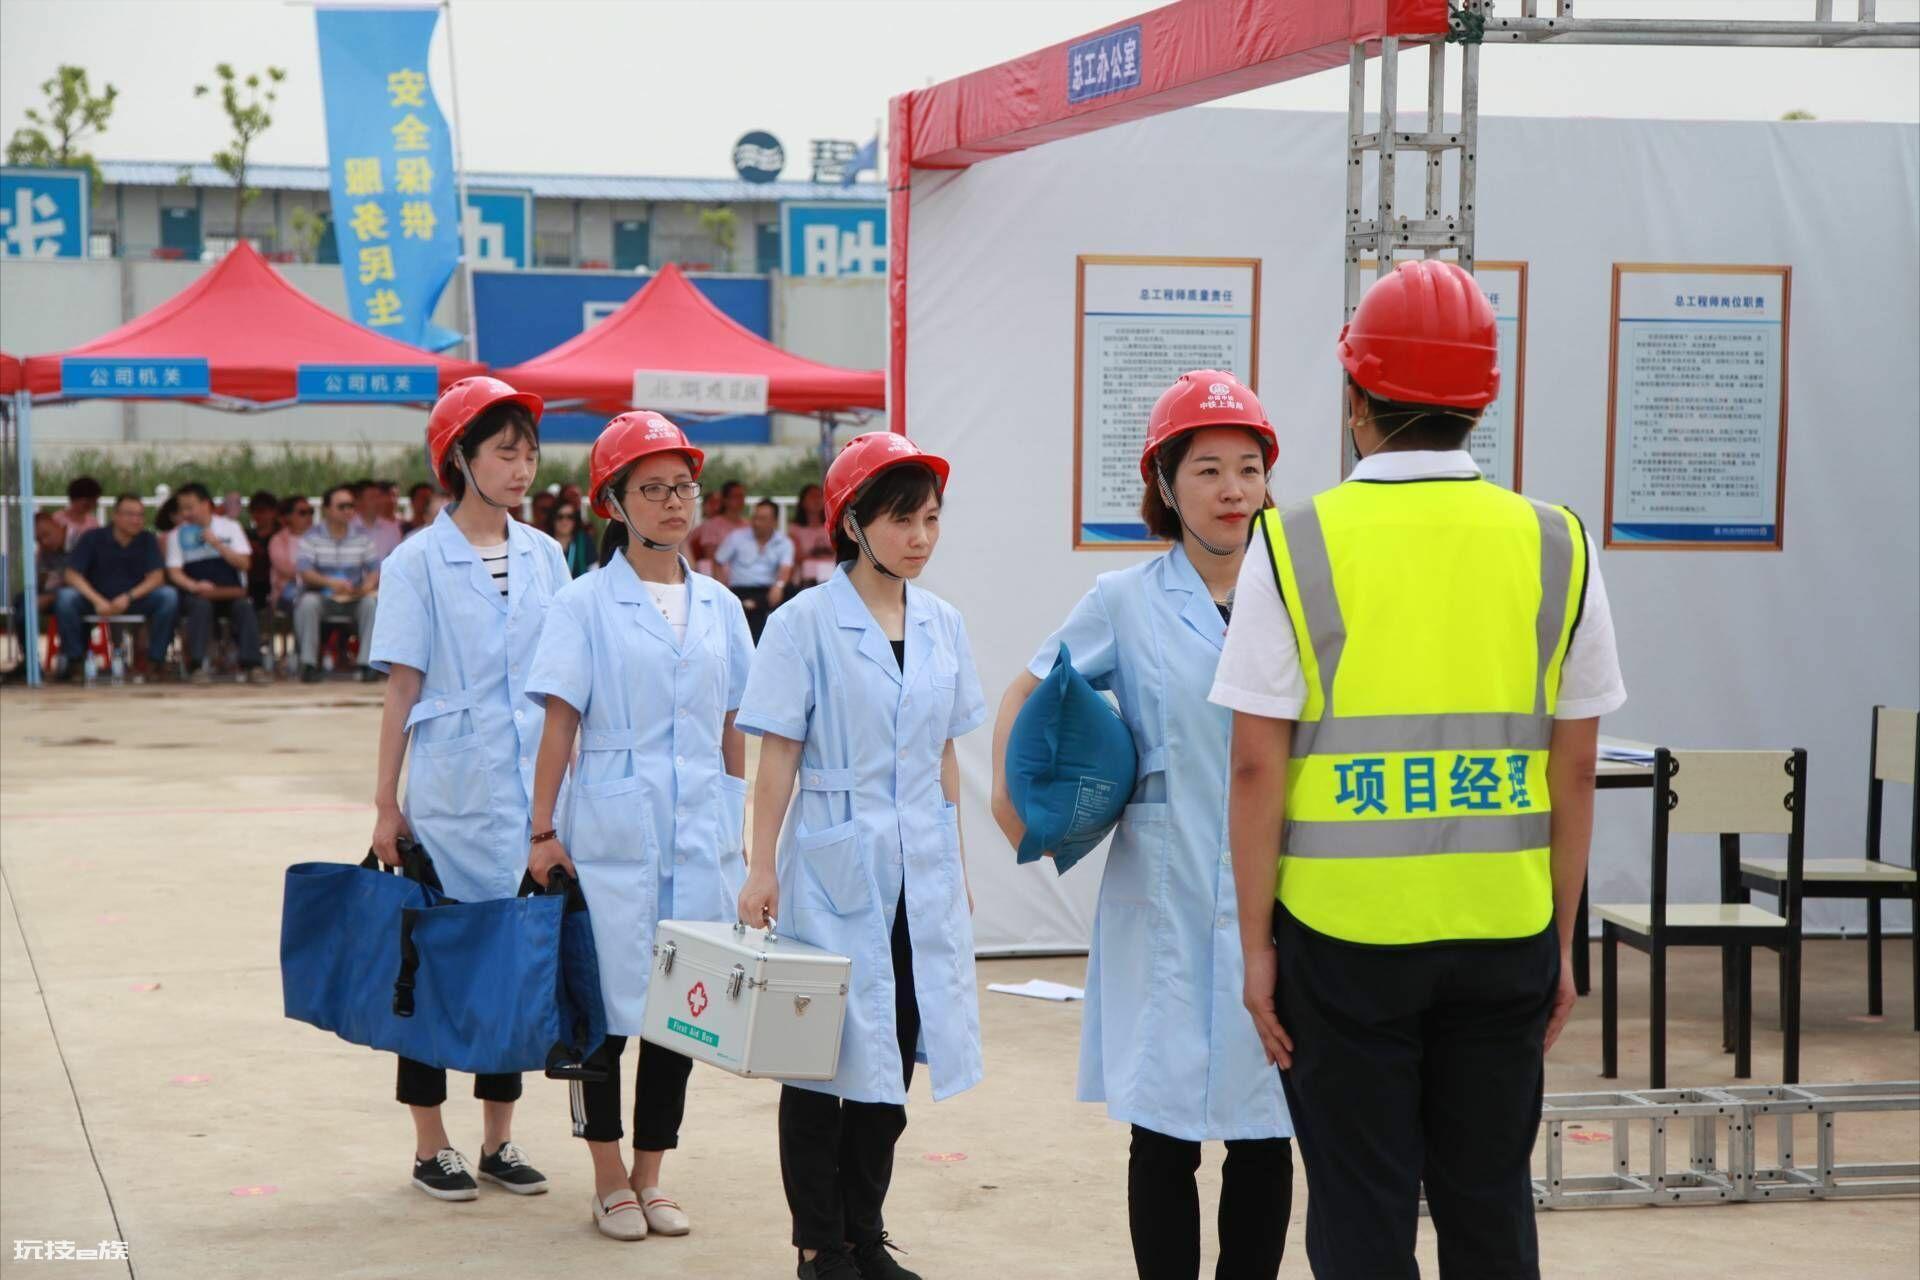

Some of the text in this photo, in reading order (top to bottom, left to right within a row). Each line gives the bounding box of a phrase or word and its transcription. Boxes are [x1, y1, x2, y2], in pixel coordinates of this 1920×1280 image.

[1072, 37, 1137, 92] 总工办公室
[1139, 287, 1233, 302] 总工程师质量责任
[1674, 295, 1765, 309] 总工程师岗位职责
[90, 367, 181, 387] 公司机关
[324, 374, 412, 393] 公司机关
[1334, 754, 1532, 815] 项目经理
[673, 1021, 687, 1034] First
